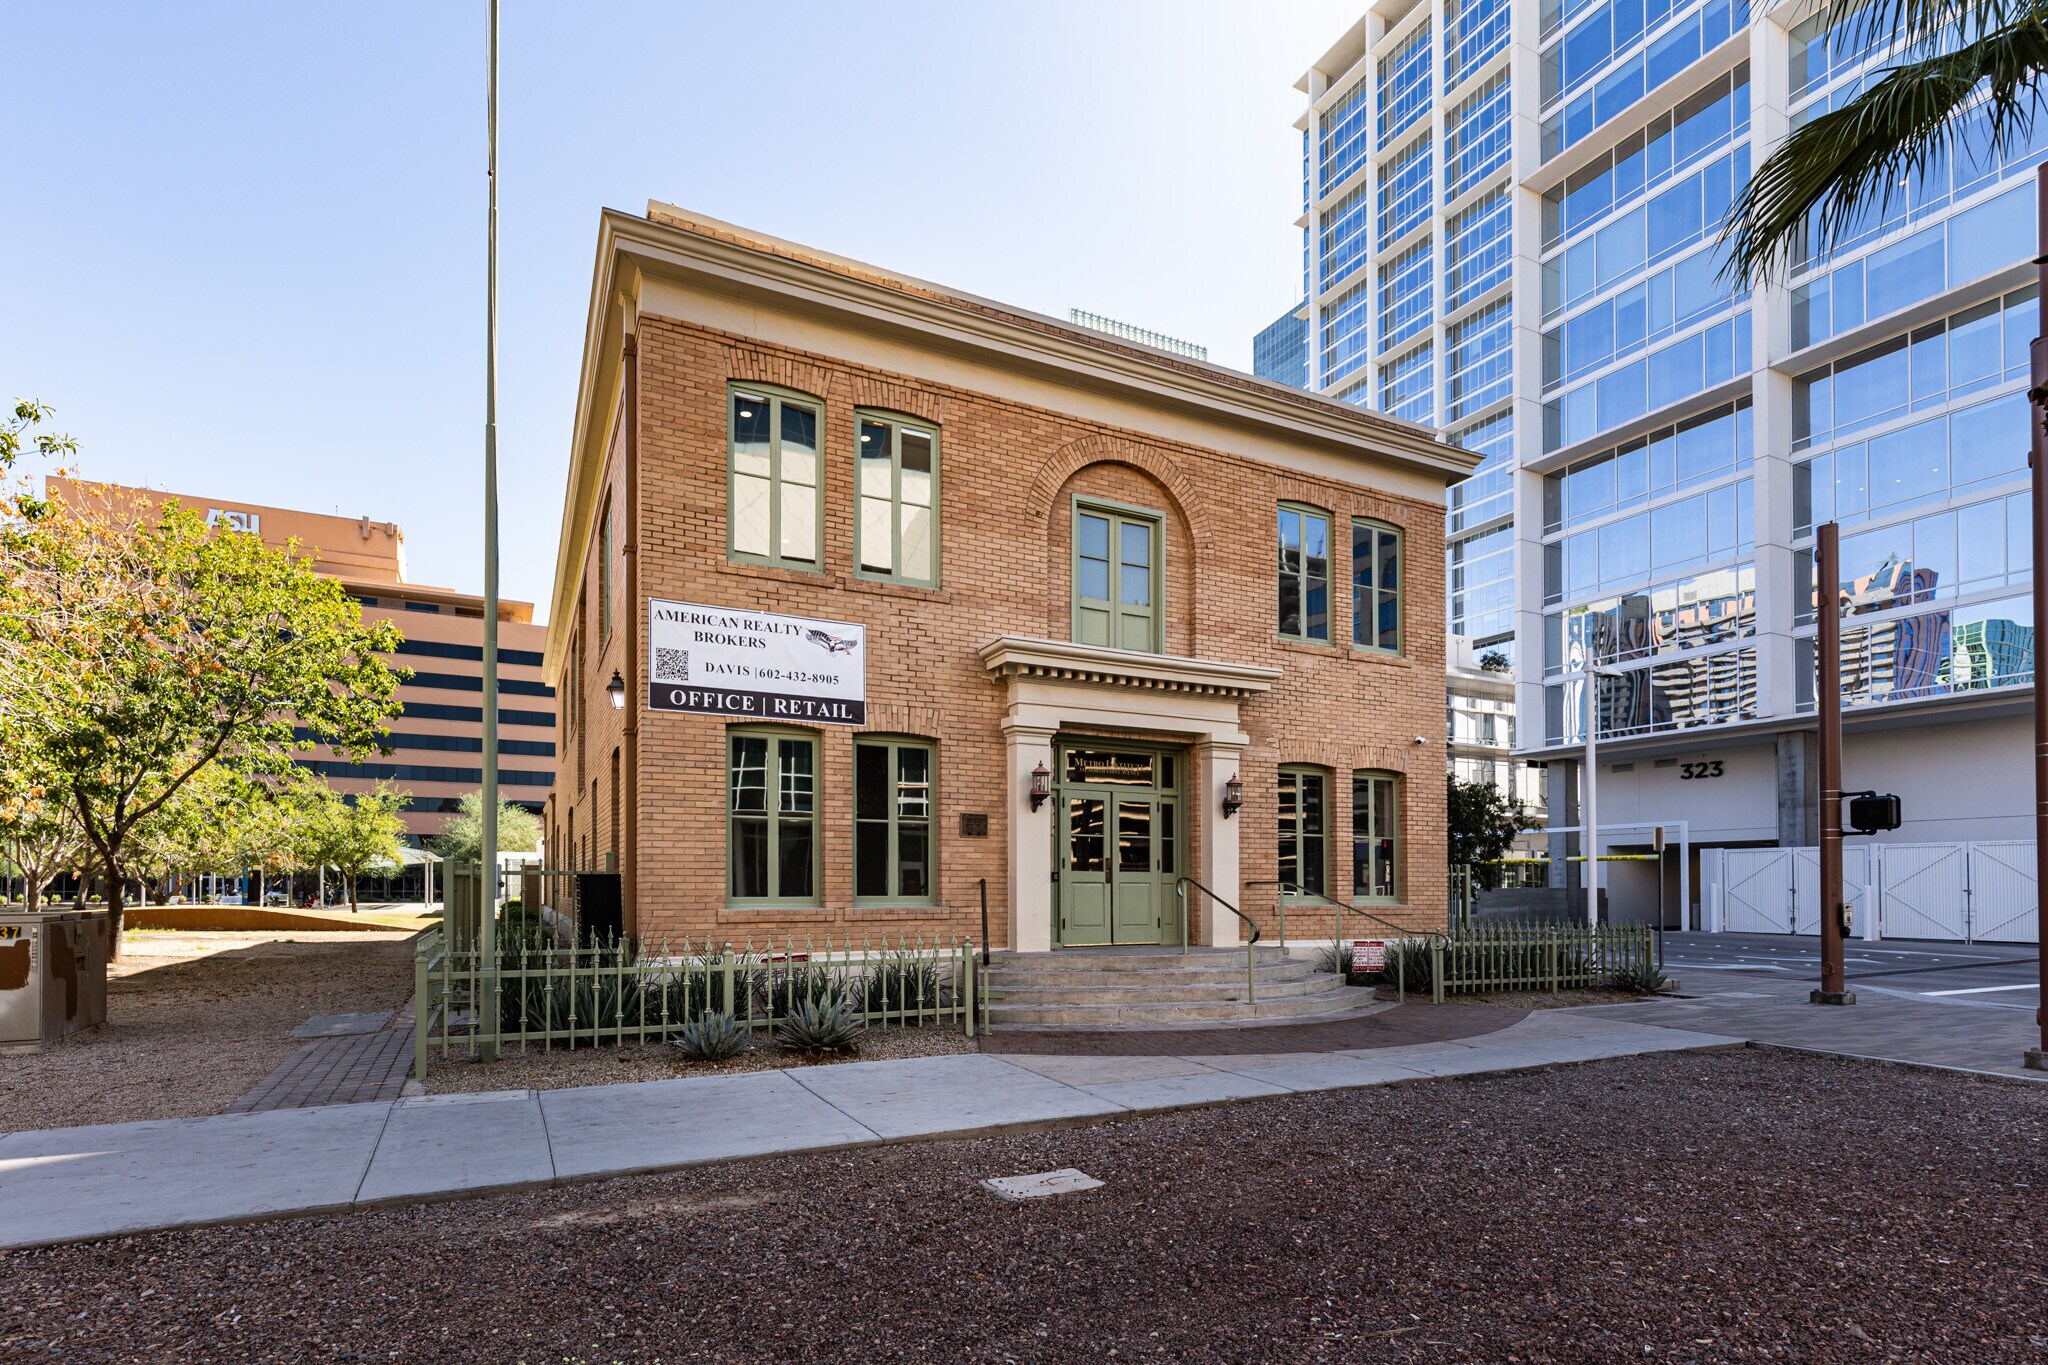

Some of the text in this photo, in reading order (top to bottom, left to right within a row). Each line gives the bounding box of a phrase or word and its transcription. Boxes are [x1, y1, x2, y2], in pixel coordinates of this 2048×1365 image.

[206, 508, 260, 534] ASU
[654, 609, 803, 636] AMERICAN REALTY
[694, 631, 767, 649] BROKERS
[705, 662, 750, 676] DAVIS
[669, 689, 755, 711] OFFICE
[774, 698, 853, 719] RETAIL
[1075, 758, 1104, 768] METRO
[1680, 760, 1724, 780] 323
